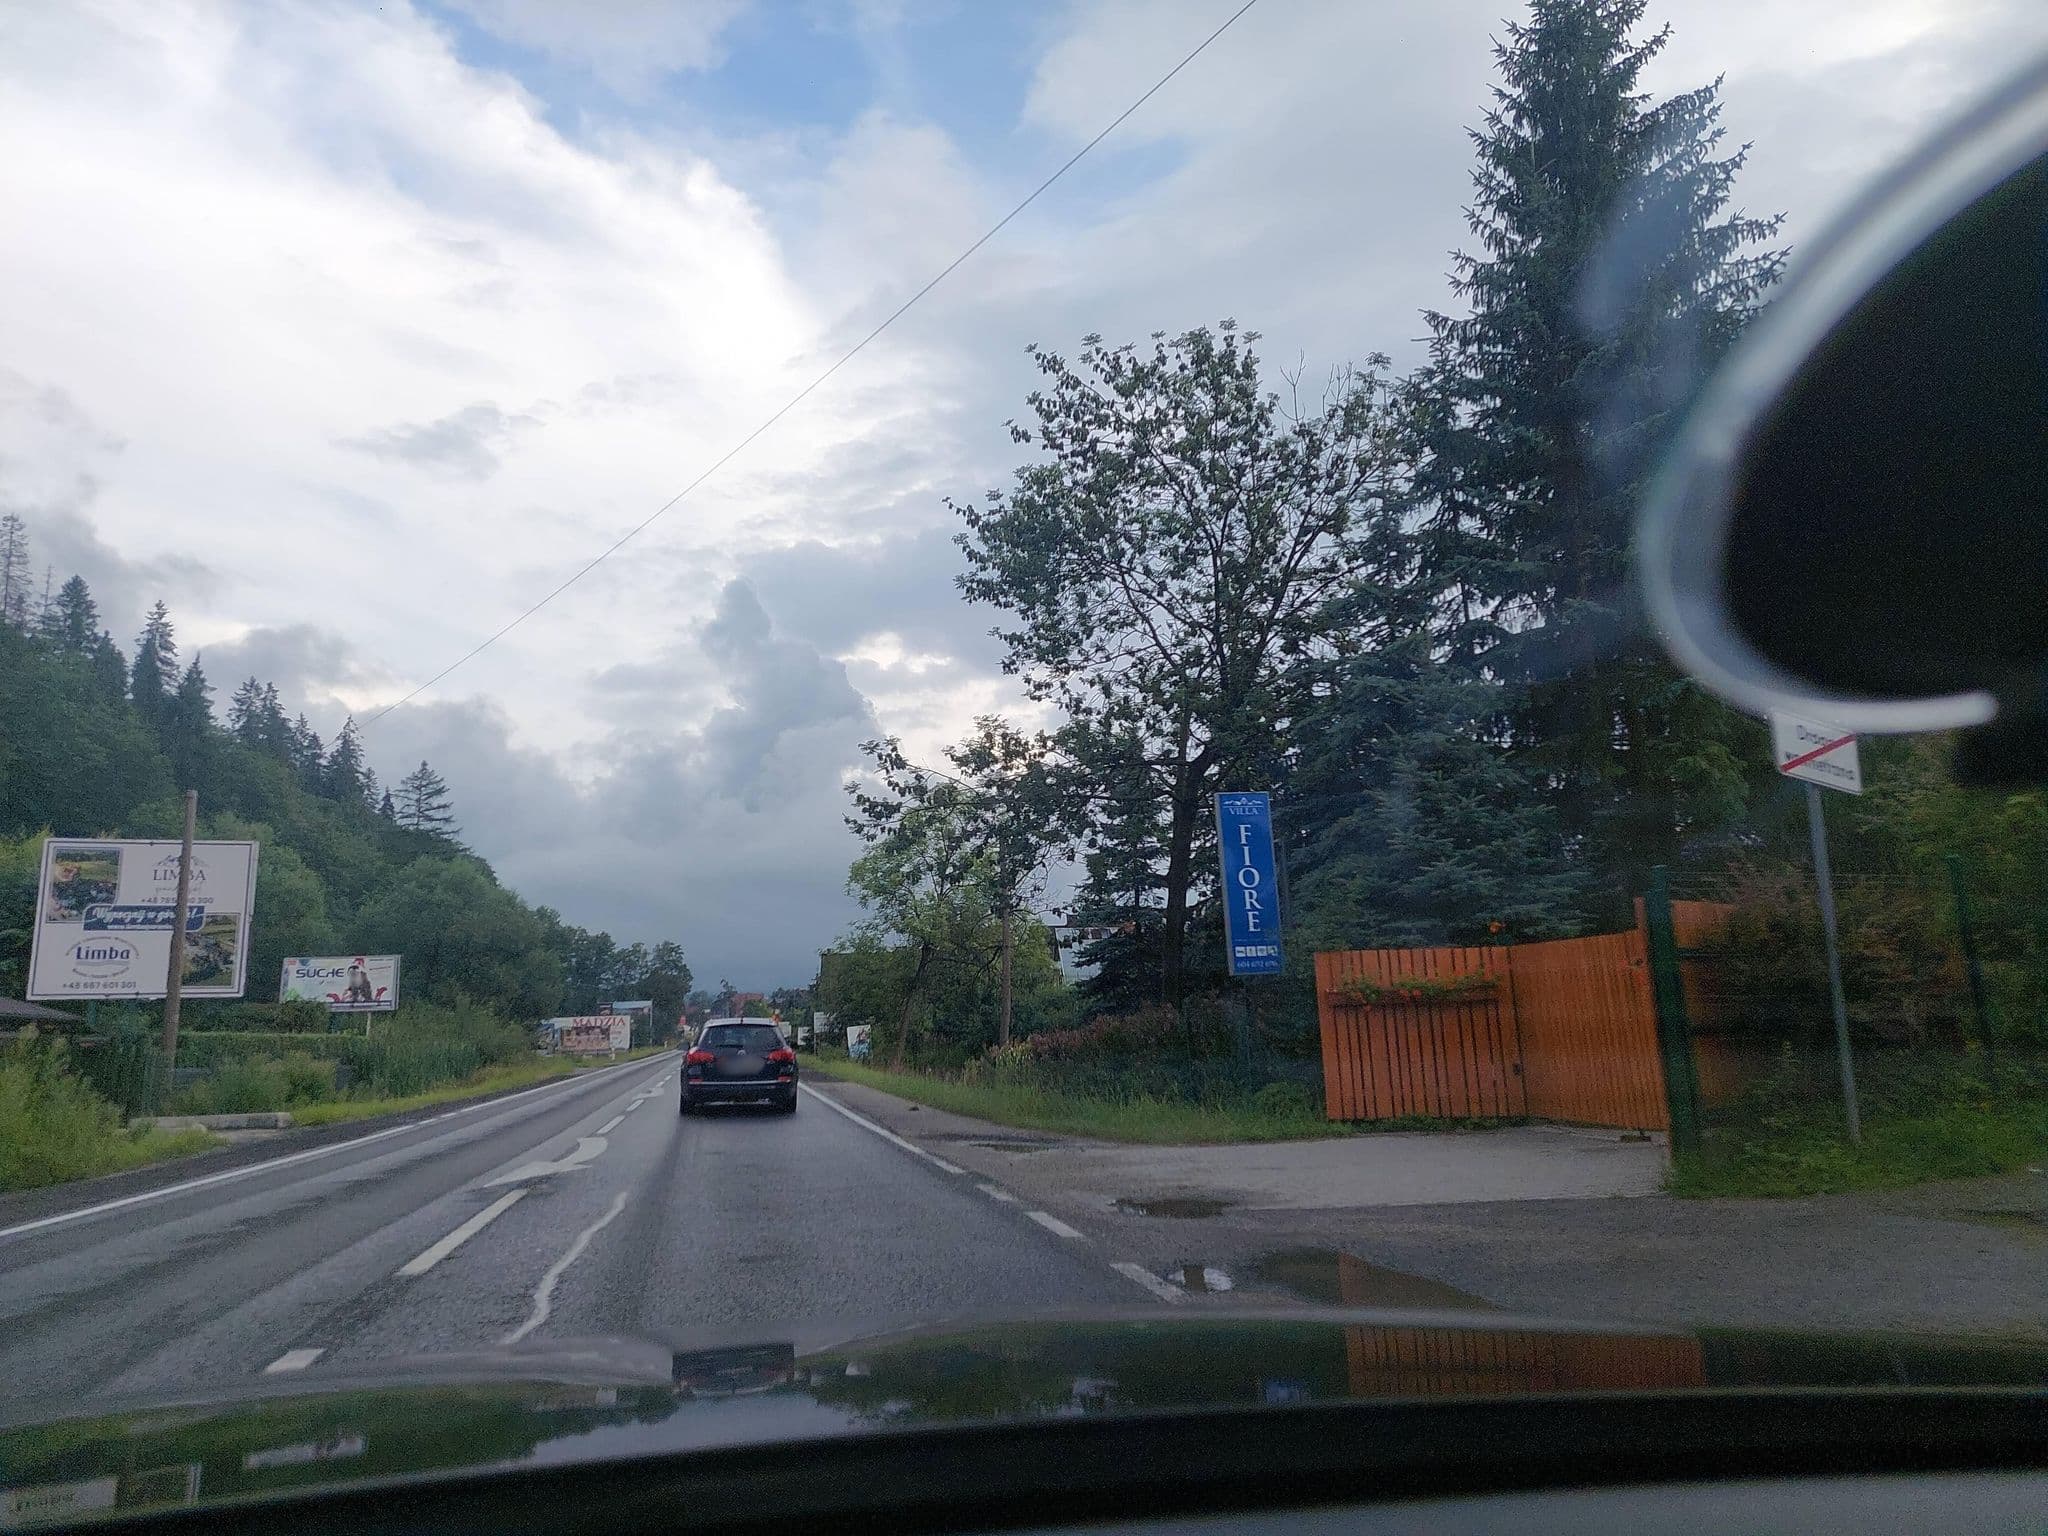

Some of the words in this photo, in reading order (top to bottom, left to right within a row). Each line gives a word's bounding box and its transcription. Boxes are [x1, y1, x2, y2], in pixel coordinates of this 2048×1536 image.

[1228, 807, 1260, 815] VILLA
[1238, 824, 1264, 932] FIORE
[76, 946, 131, 960] Limba
